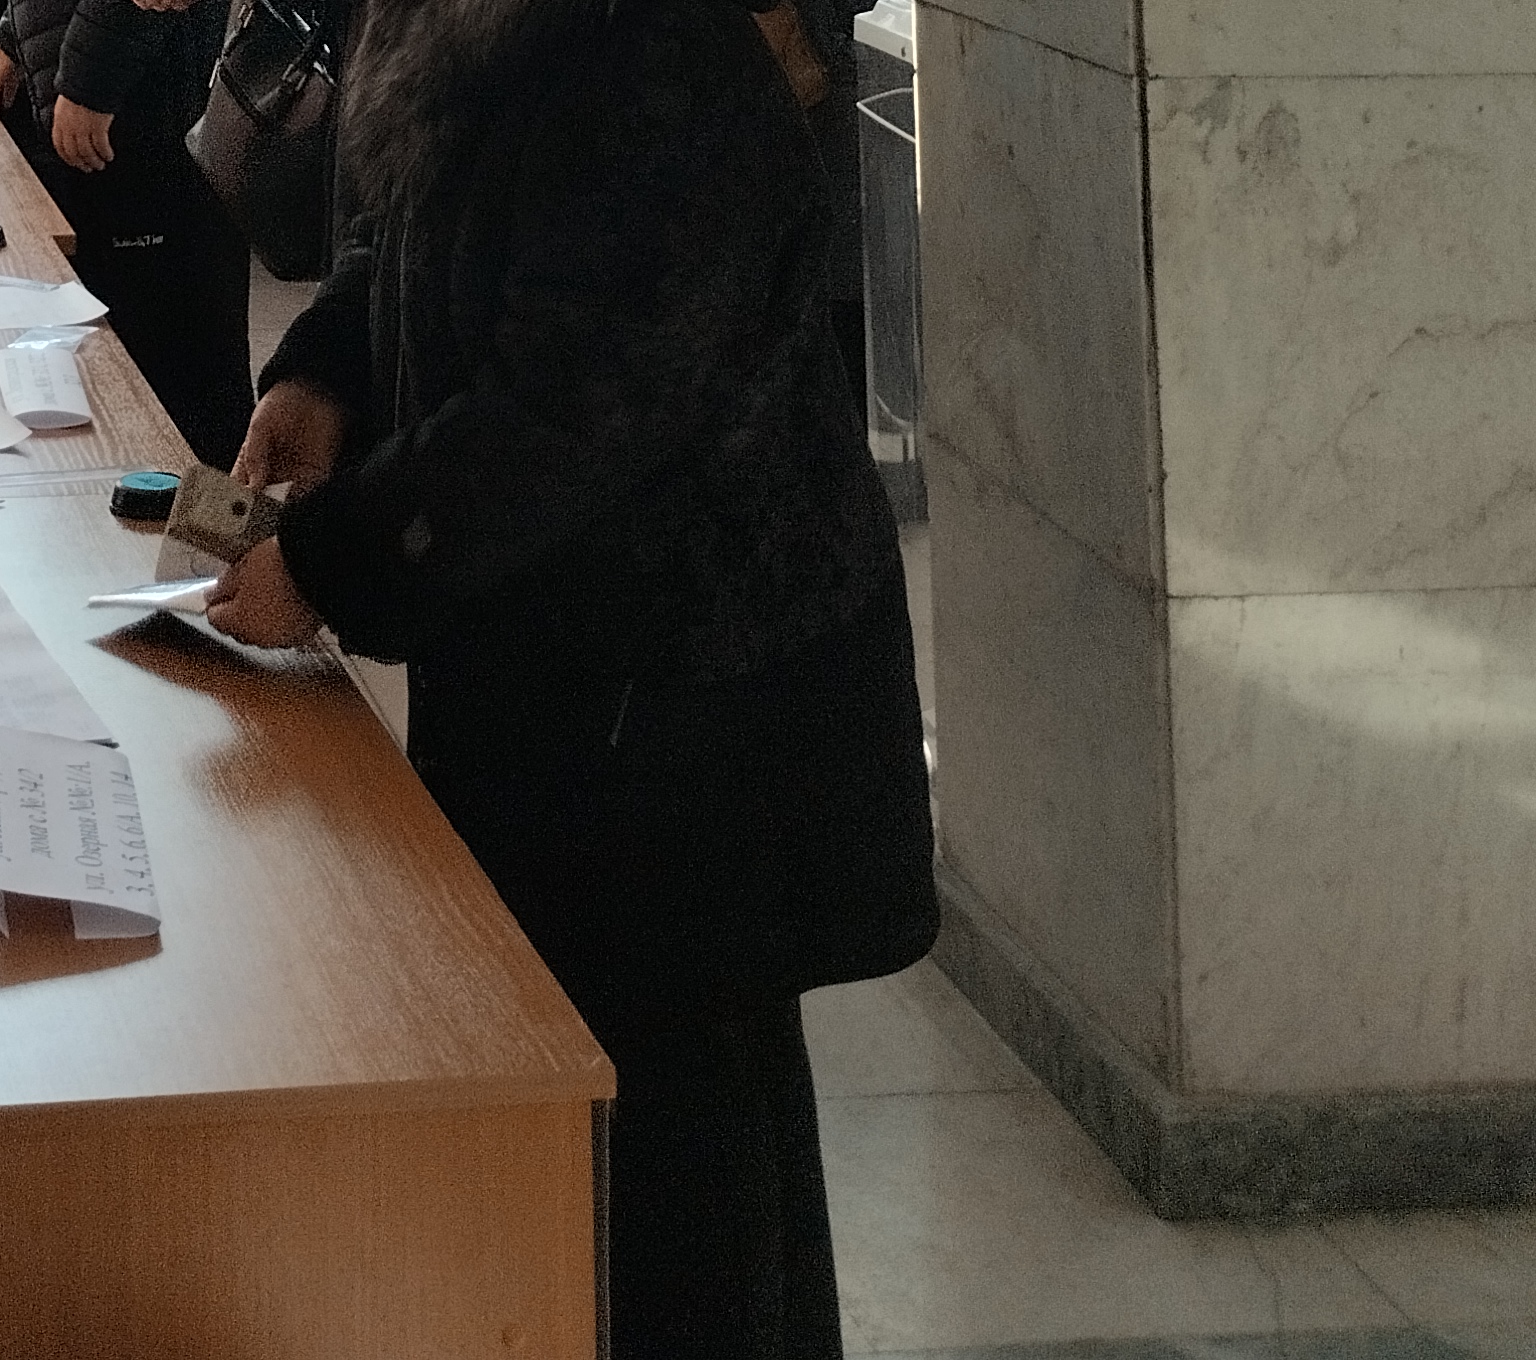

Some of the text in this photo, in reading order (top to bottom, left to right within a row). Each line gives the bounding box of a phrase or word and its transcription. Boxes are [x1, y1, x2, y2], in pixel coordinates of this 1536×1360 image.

[28, 824, 54, 860] дома
[74, 815, 109, 868] Озерная
[85, 871, 115, 894] ул.
